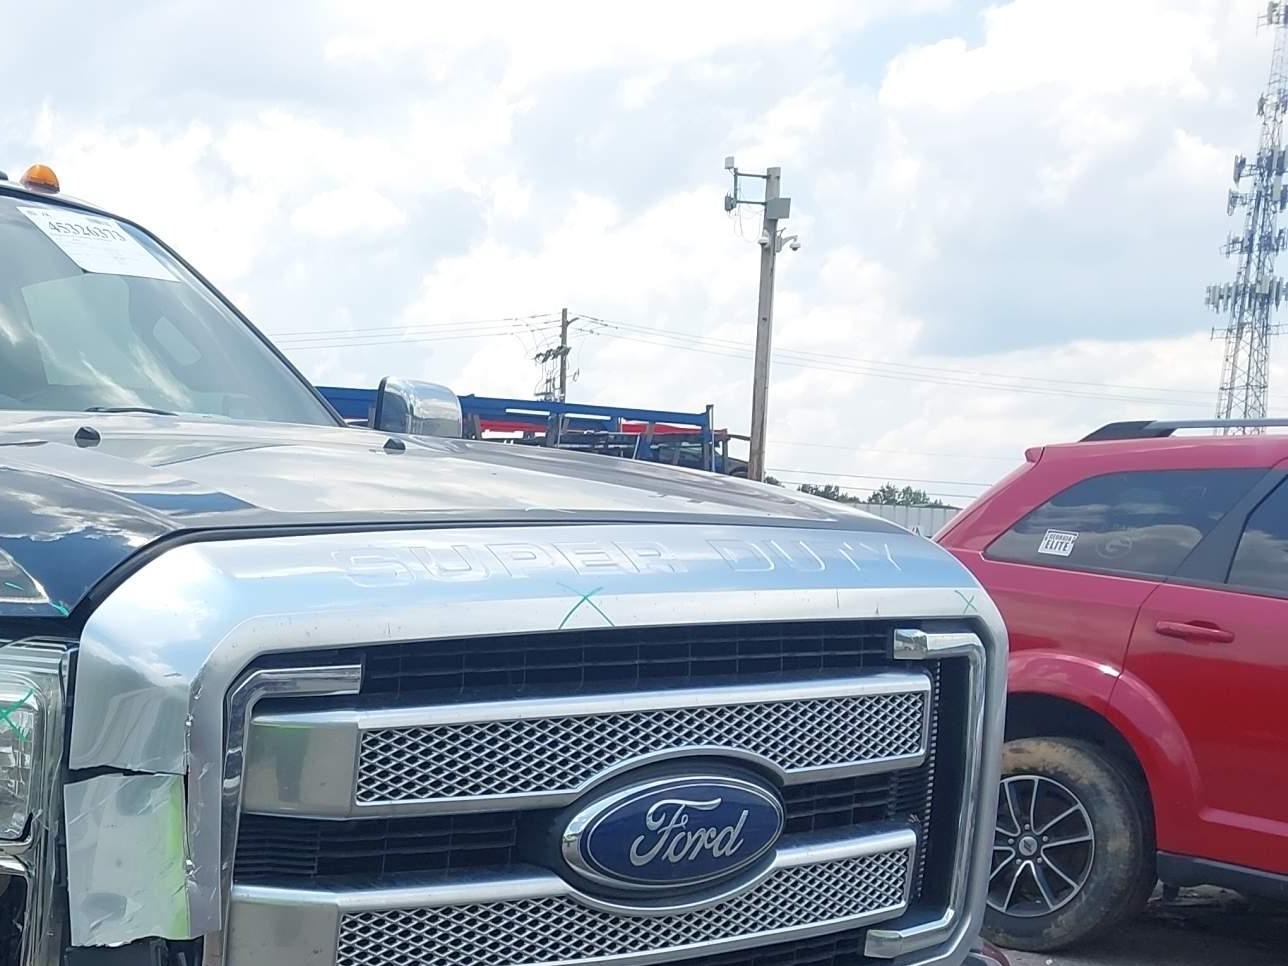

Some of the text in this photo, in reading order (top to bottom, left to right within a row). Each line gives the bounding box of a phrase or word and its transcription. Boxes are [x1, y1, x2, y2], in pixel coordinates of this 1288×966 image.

[331, 541, 688, 586] SUPER
[1044, 540, 1070, 552] ELITE
[629, 798, 749, 866] Ford
